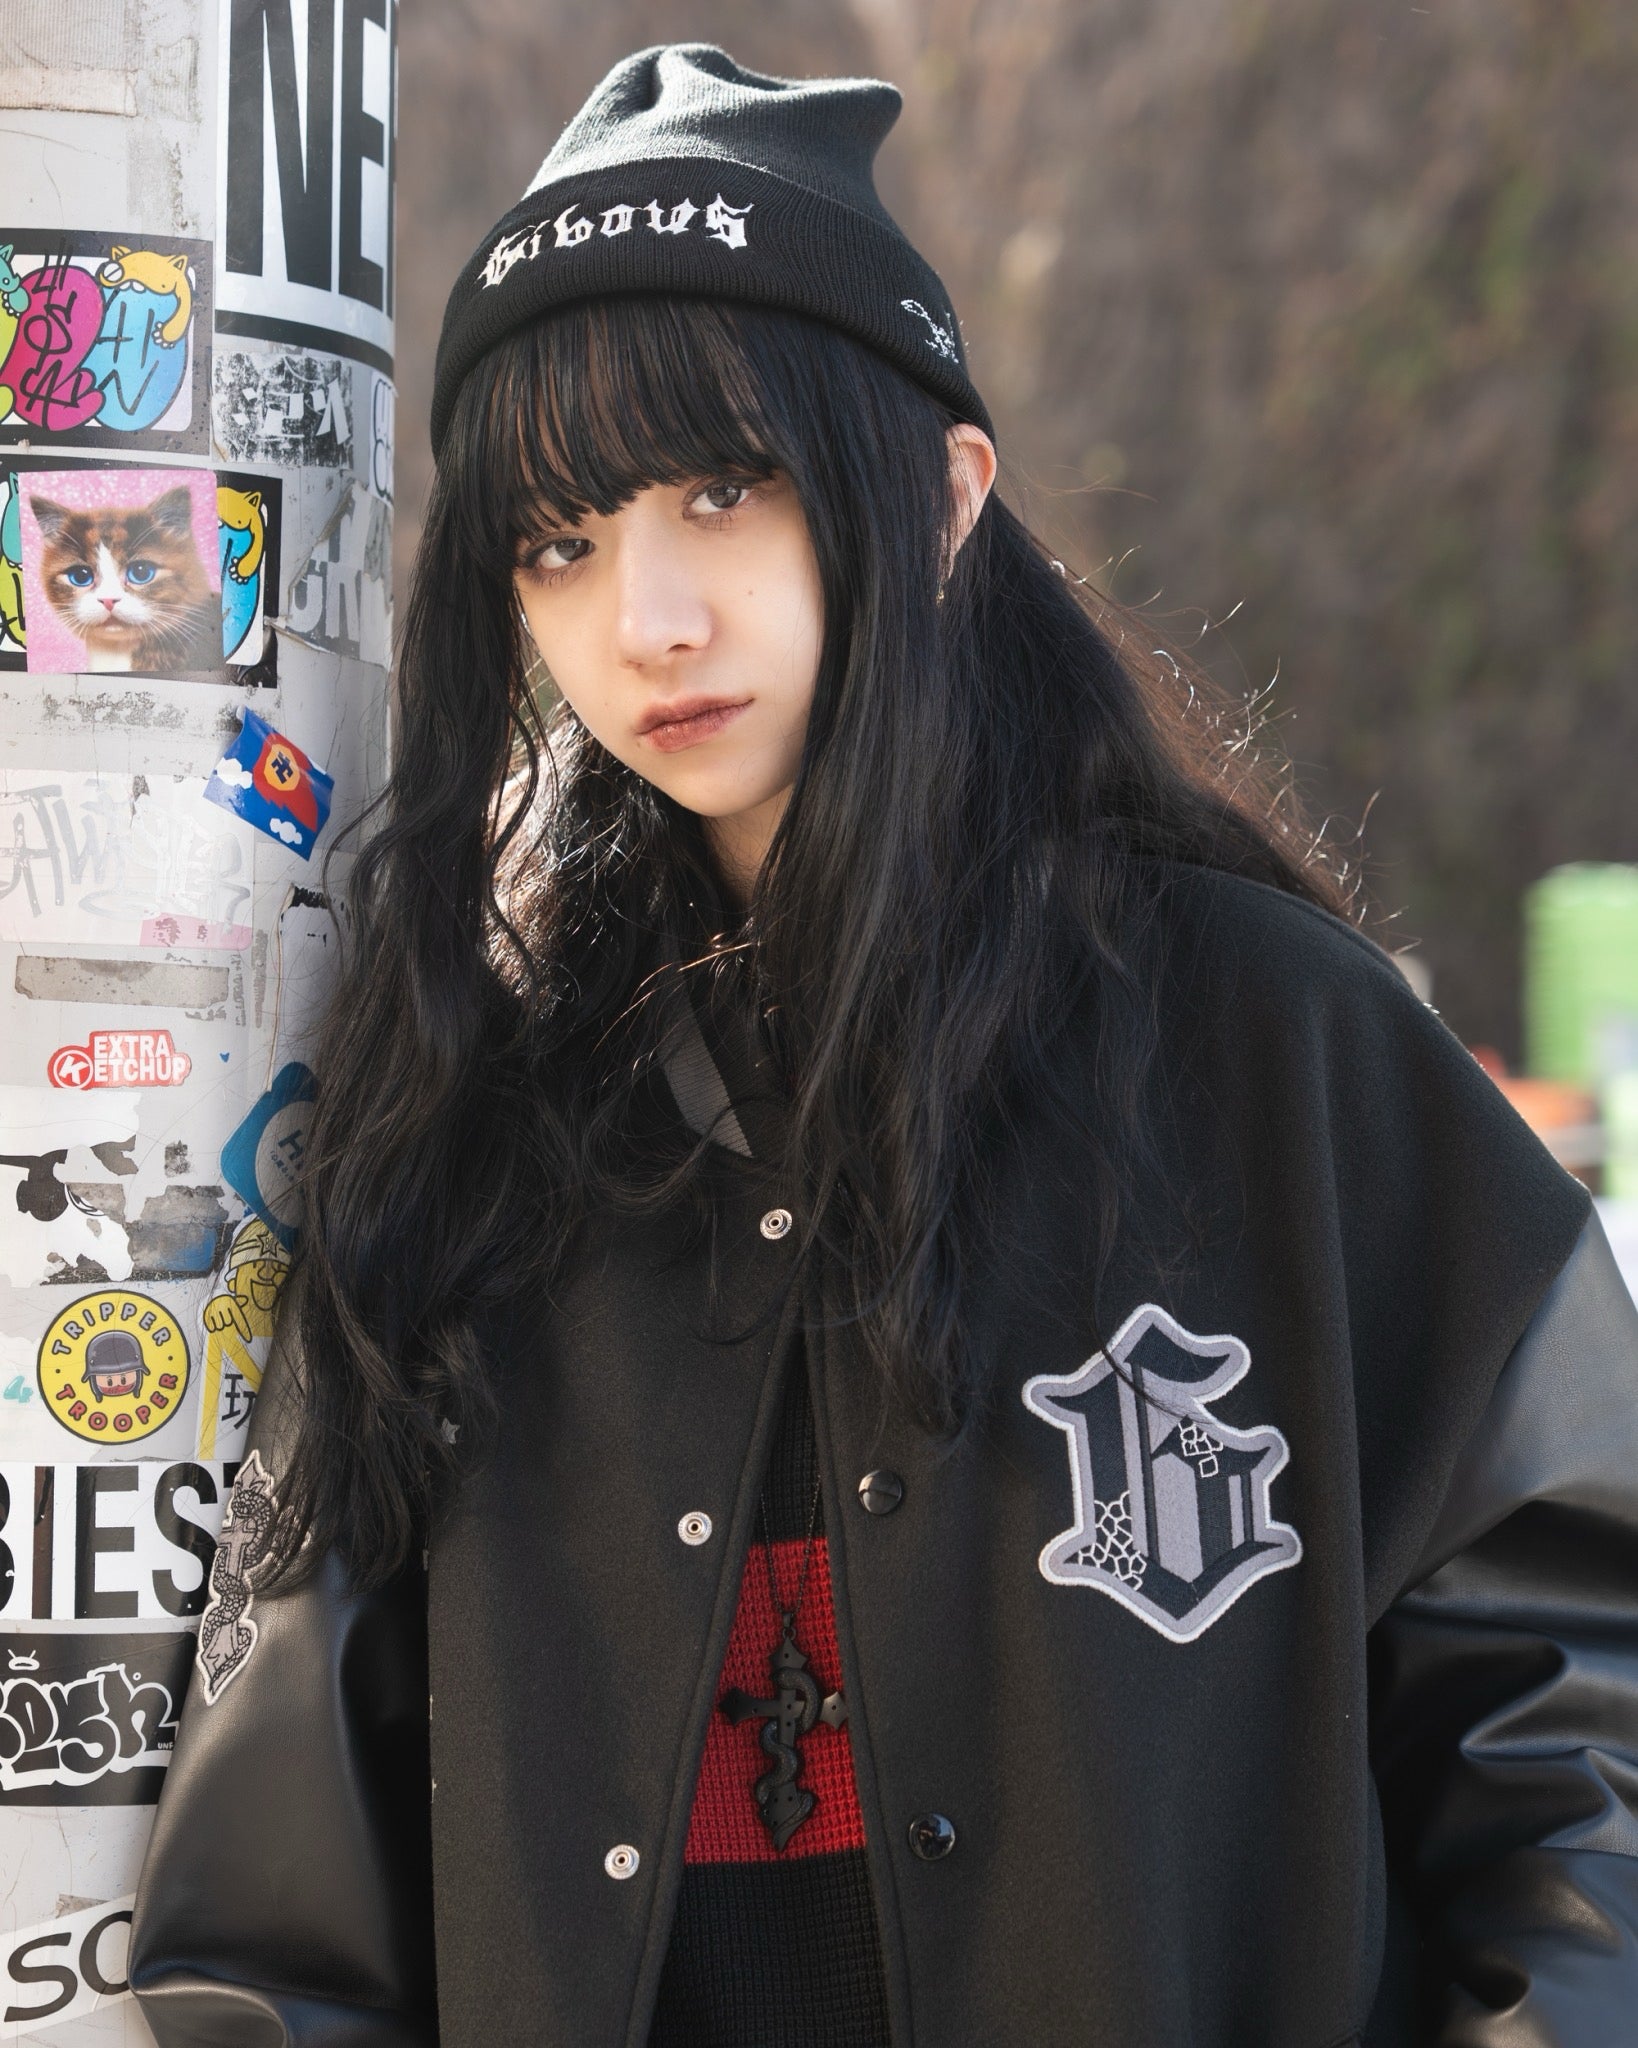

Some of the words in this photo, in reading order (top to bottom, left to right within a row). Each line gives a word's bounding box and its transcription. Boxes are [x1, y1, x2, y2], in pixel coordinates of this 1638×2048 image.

[226, 0, 393, 322] NE
[94, 1035, 171, 1058] EXTRA
[52, 1302, 171, 1355] TRIPPER
[56, 1373, 178, 1432] TROOPER
[0, 1462, 240, 1619] IES
